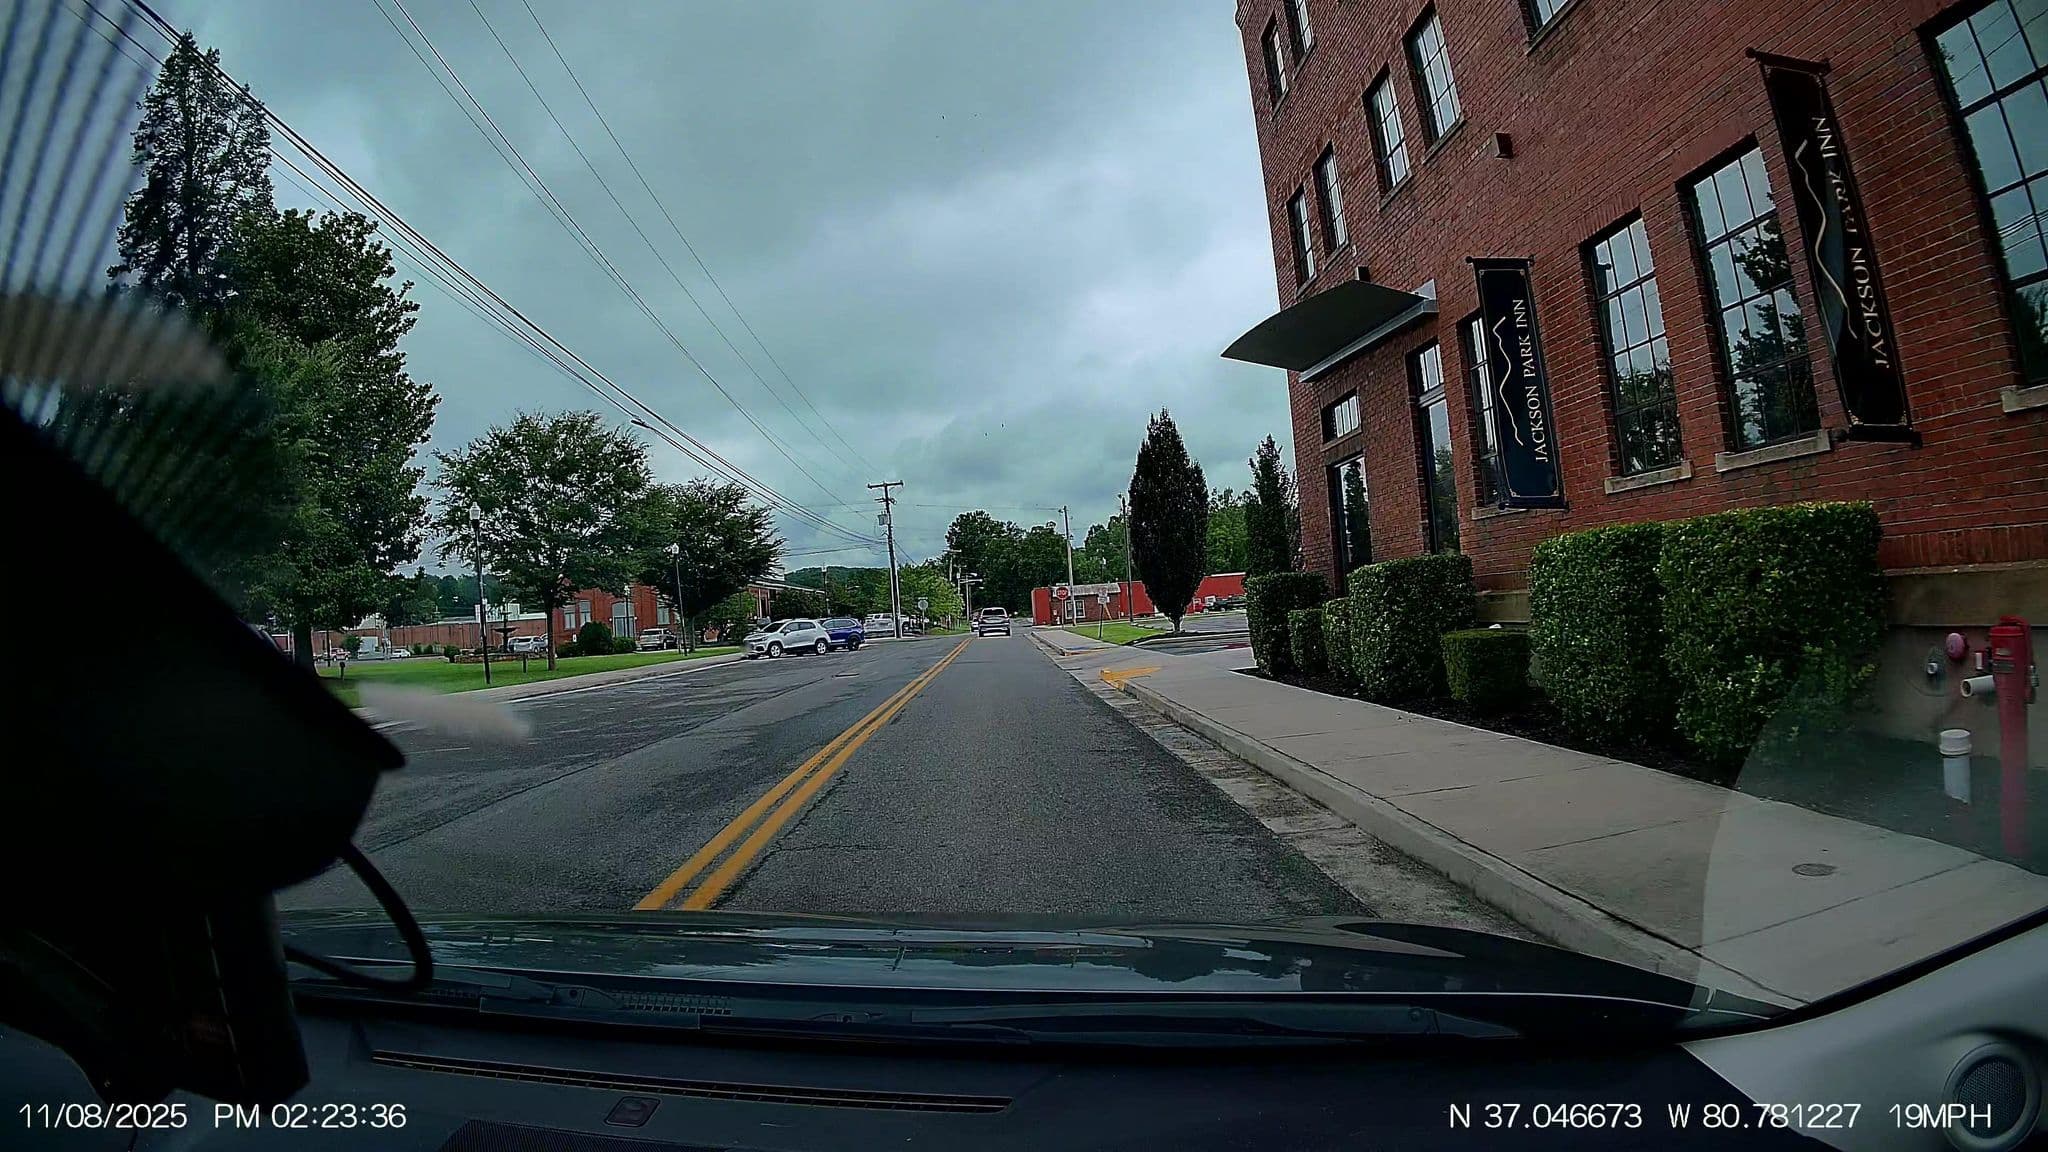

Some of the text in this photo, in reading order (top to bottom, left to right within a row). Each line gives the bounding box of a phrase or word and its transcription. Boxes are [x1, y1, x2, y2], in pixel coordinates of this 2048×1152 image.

[1811, 117, 1838, 158] INN
[1850, 247, 1890, 369] JACKSON
[1512, 299, 1549, 463] JACKSON PARK INN
